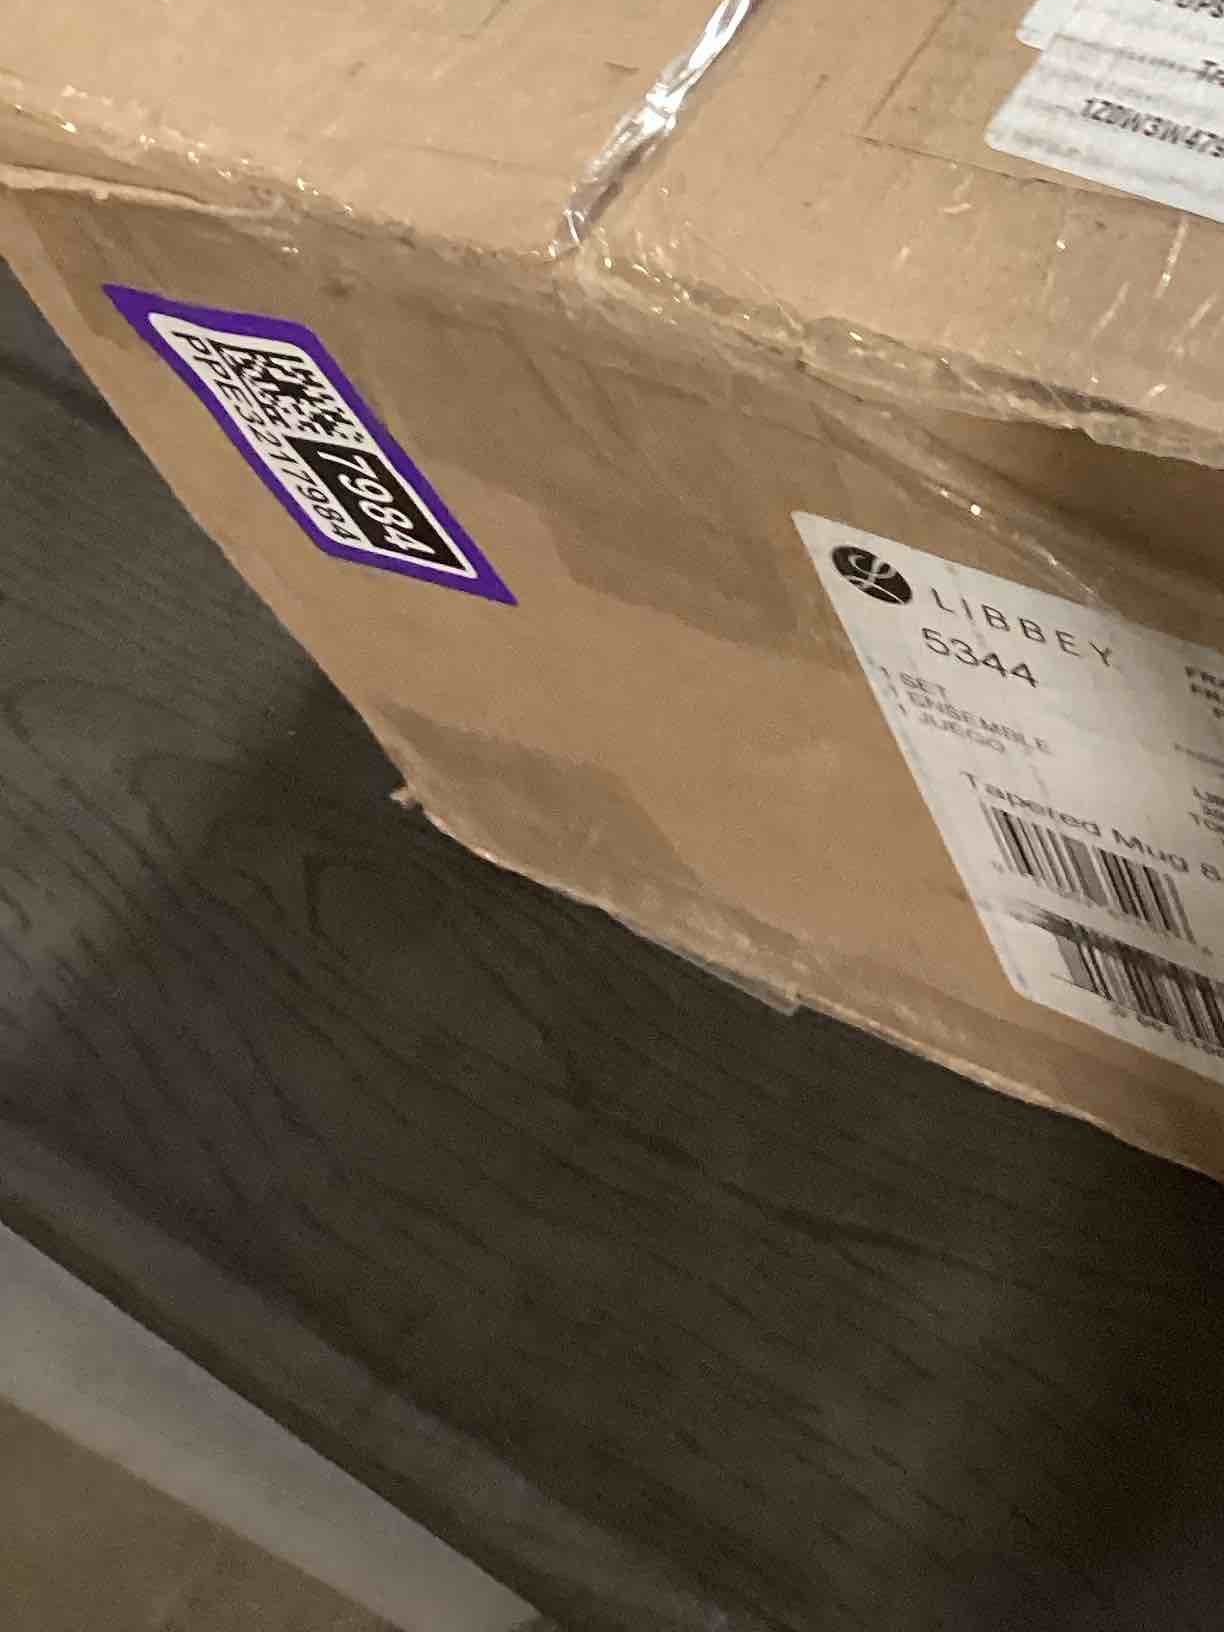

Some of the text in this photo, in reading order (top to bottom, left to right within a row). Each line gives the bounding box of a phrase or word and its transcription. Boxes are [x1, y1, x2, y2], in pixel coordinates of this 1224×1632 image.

[171, 330, 362, 543] PPE3217984
[316, 448, 437, 556] 7984
[921, 627, 1039, 689] 5344
[930, 585, 1112, 667] LIBBEY
[959, 769, 1102, 838] Tapered
[1111, 827, 1189, 874] Mug
